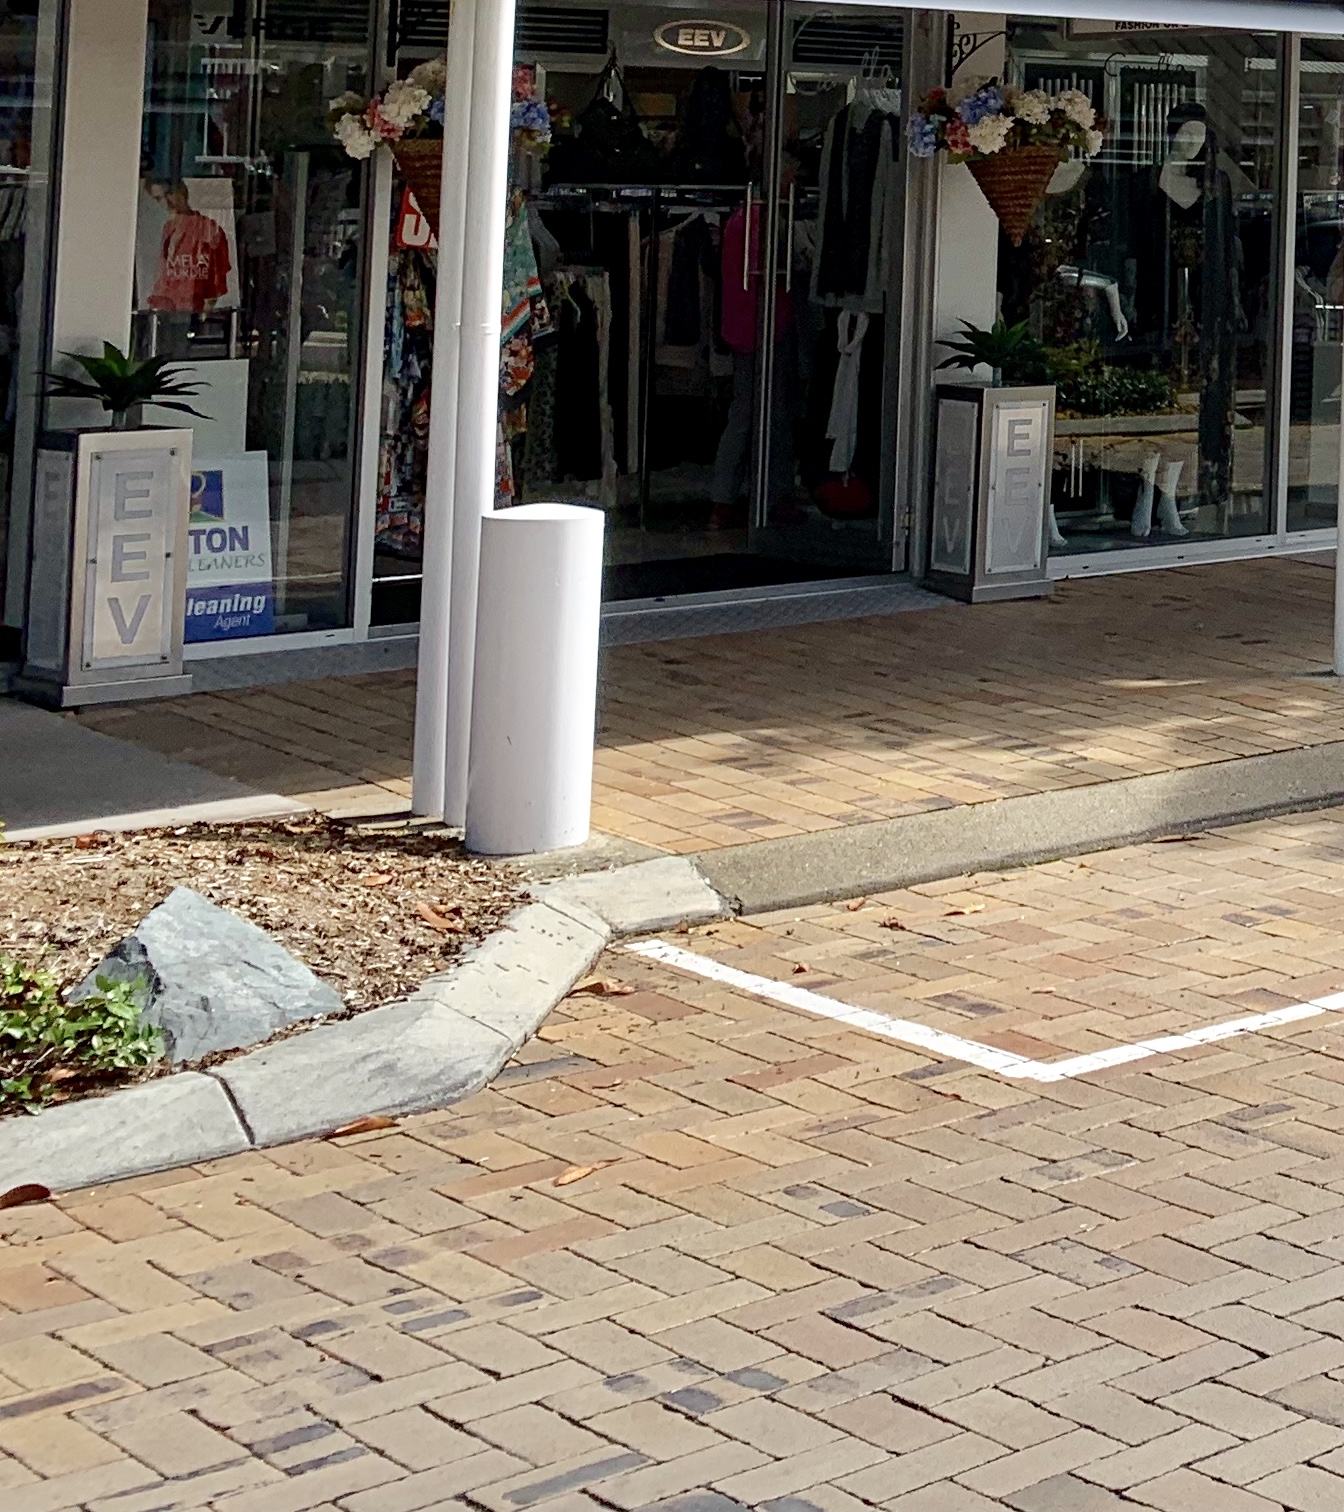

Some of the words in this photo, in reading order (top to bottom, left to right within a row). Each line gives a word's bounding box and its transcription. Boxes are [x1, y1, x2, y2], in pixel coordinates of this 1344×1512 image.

[677, 28, 726, 47] EEV
[188, 525, 250, 555] TON
[107, 471, 155, 645] EEV
[189, 553, 266, 573] LEANERS
[187, 593, 266, 617] leaning
[214, 614, 251, 631] Agent
